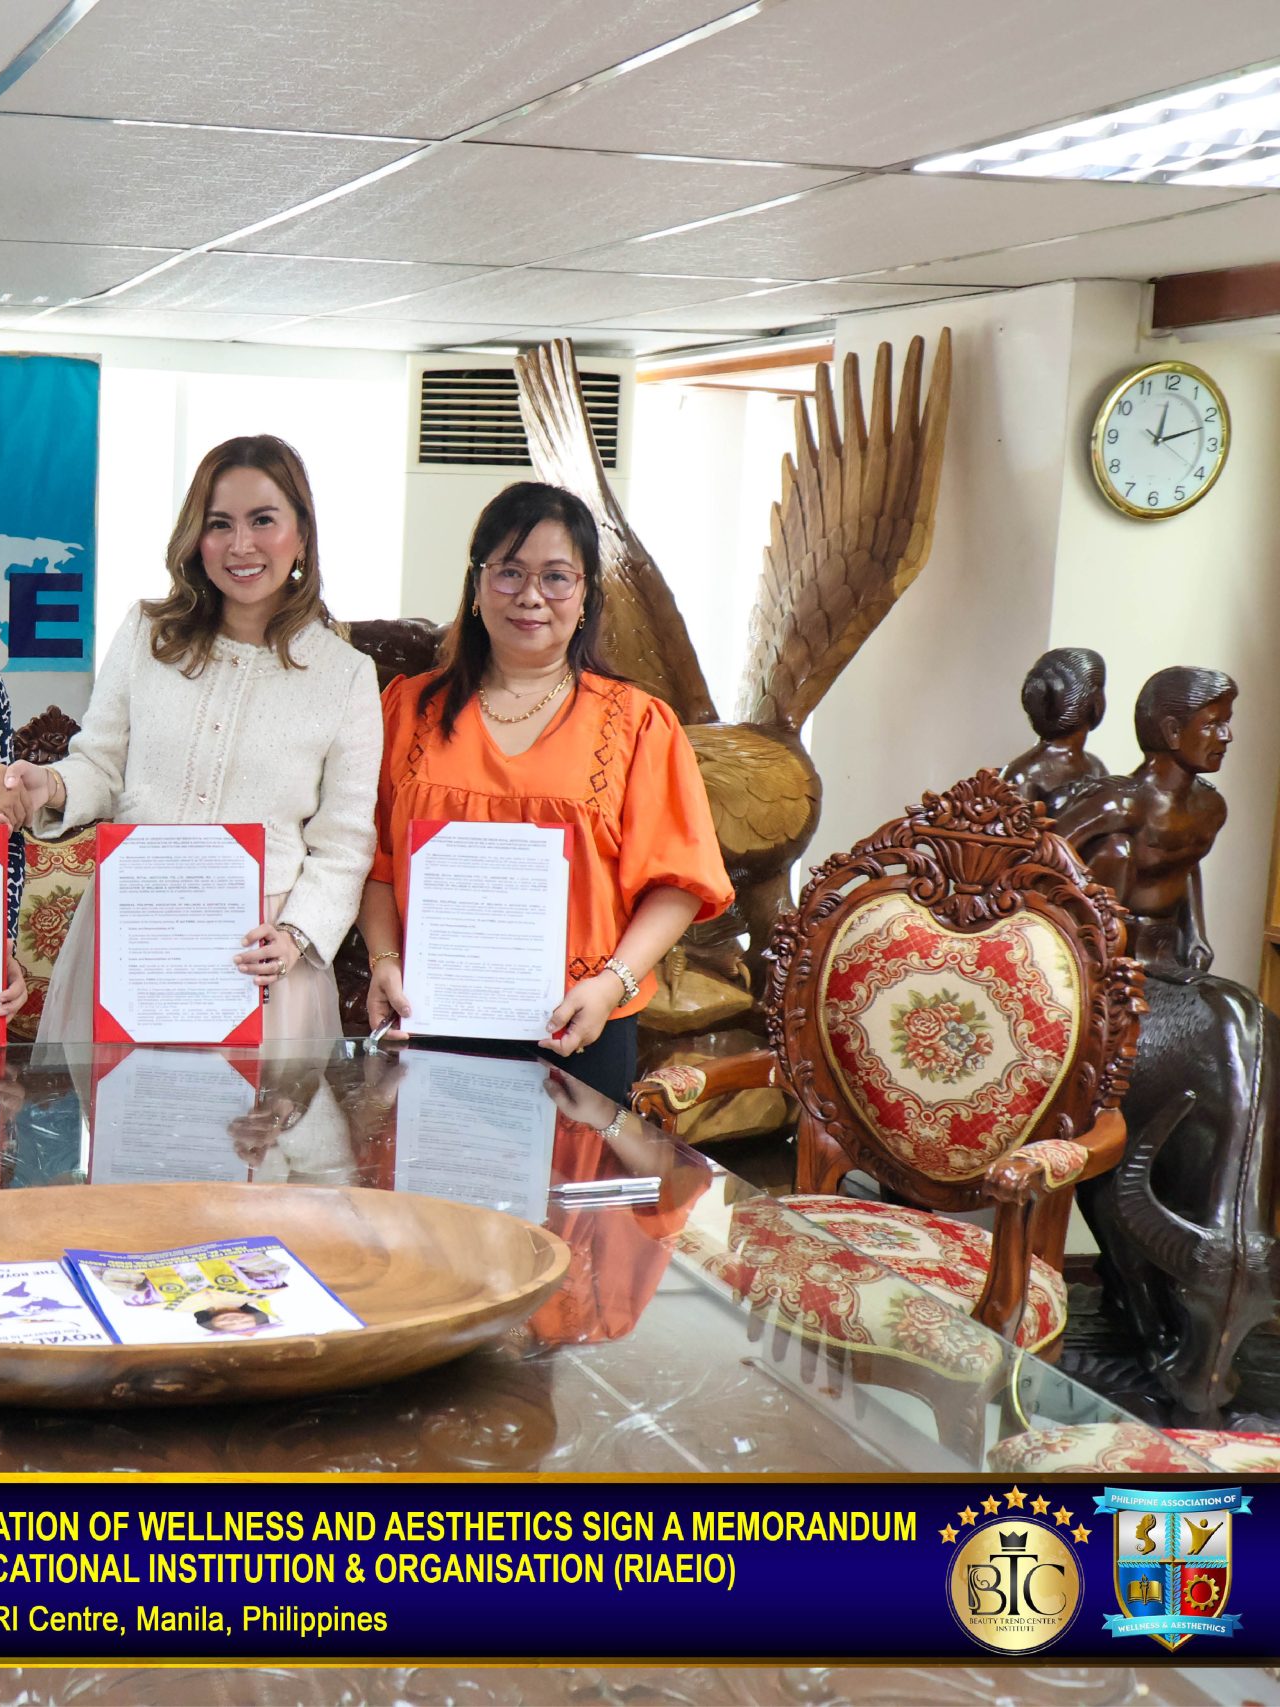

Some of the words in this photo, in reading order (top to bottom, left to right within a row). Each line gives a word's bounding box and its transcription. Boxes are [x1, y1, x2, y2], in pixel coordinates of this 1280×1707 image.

[1140, 380, 1152, 396] 11
[1165, 374, 1181, 391] 12
[1118, 400, 1133, 416] 10
[1204, 407, 1218, 422] 2
[1107, 428, 1118, 444] 9
[1206, 437, 1218, 452] 3
[1109, 458, 1120, 473] 8
[1194, 466, 1205, 480] 4
[1125, 482, 1136, 497] 7
[1174, 485, 1185, 500] 5
[1148, 491, 1159, 506] 6
